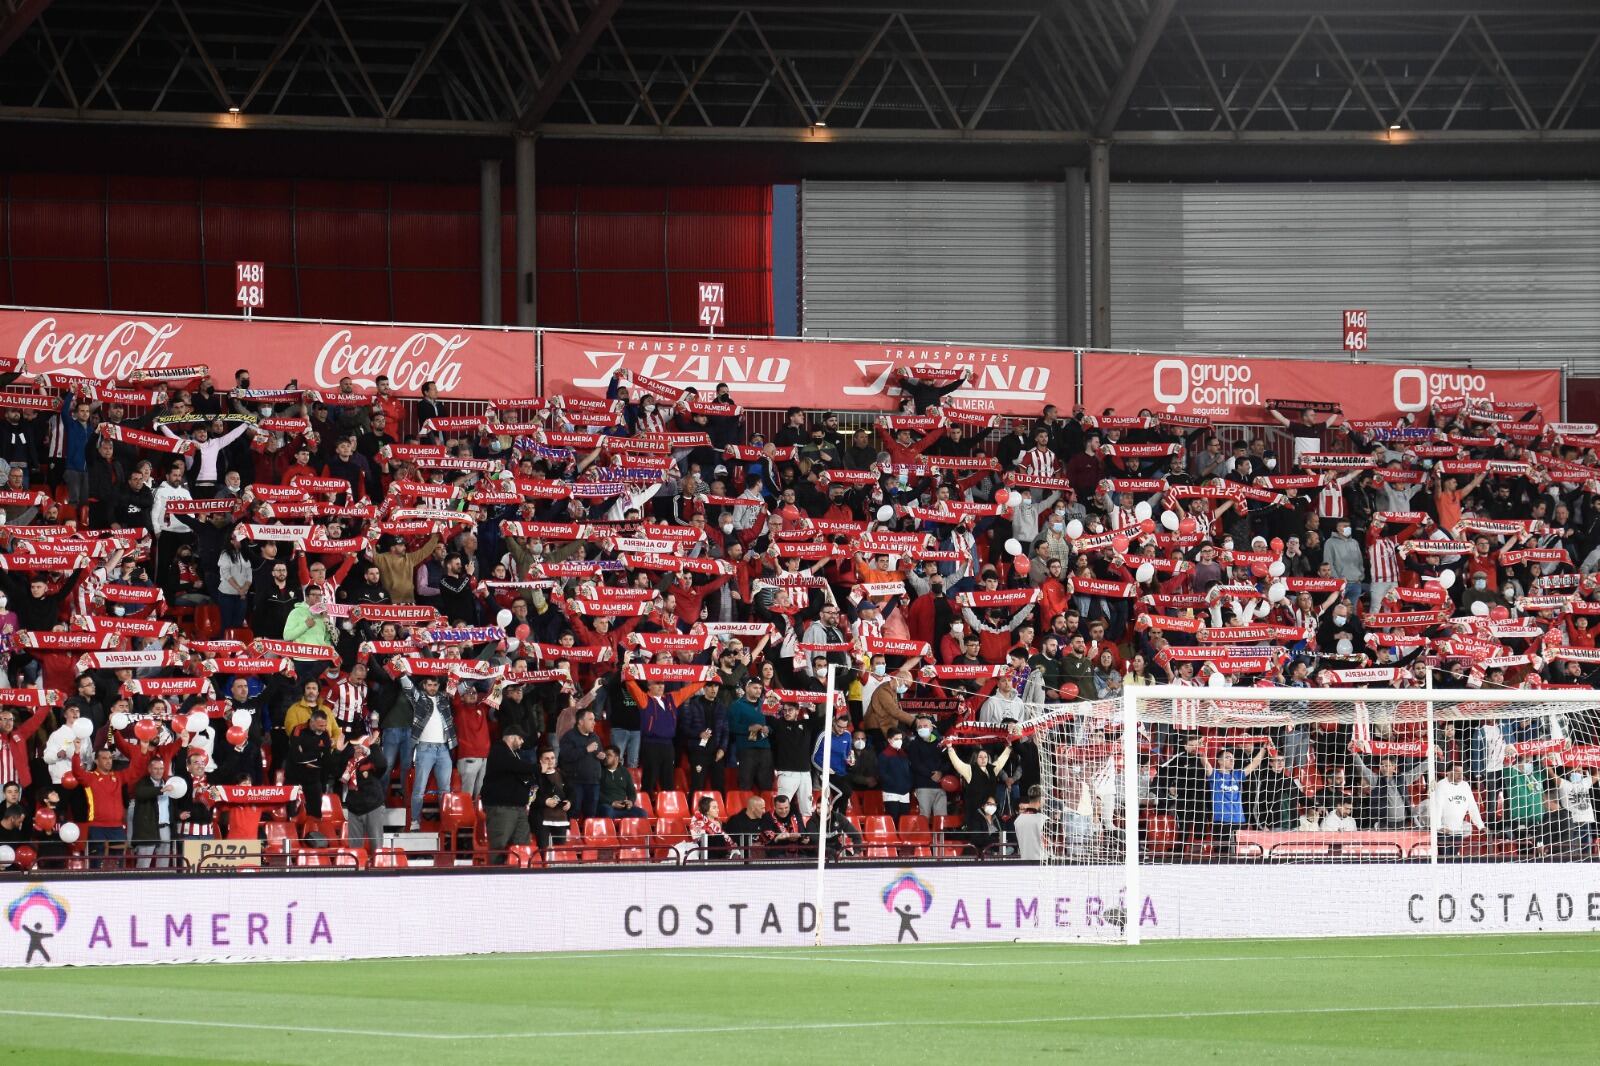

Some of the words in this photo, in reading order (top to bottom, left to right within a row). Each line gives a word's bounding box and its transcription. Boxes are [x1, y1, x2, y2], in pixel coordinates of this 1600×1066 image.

[238, 265, 259, 282] 148
[237, 286, 259, 305] 48
[700, 286, 719, 302] 147
[700, 306, 720, 324] 47
[1345, 312, 1363, 328] 146
[1344, 332, 1362, 349] 46
[16, 317, 183, 380] Coca-Cola
[616, 341, 752, 354] TRANSPORTES
[314, 330, 472, 392] Coca-Cola
[885, 350, 1009, 362] TRANSPORTES
[1191, 363, 1251, 386] grupo
[1430, 373, 1485, 395] grupo
[1192, 383, 1260, 405] control
[1193, 407, 1229, 415] seguridad
[29, 556, 67, 564] ALMERÍA
[1091, 582, 1119, 591] ALMERÍA
[1305, 579, 1337, 587] ALMERÍA
[119, 589, 152, 598] ALMERÍA
[602, 603, 633, 611] ALMERÍA
[116, 621, 153, 631] ALMERÍA
[58, 635, 96, 643] ALMERÍA
[663, 637, 698, 646] ALMERÍA
[885, 642, 917, 650] ALMERÍA
[237, 659, 273, 667] ALMERÍA
[663, 668, 695, 676] ALMERÍA
[162, 680, 196, 689] ALMERÍA
[232, 788, 245, 796] UD
[247, 788, 284, 796] ALMERÍA
[88, 901, 333, 948] ALMERÍA
